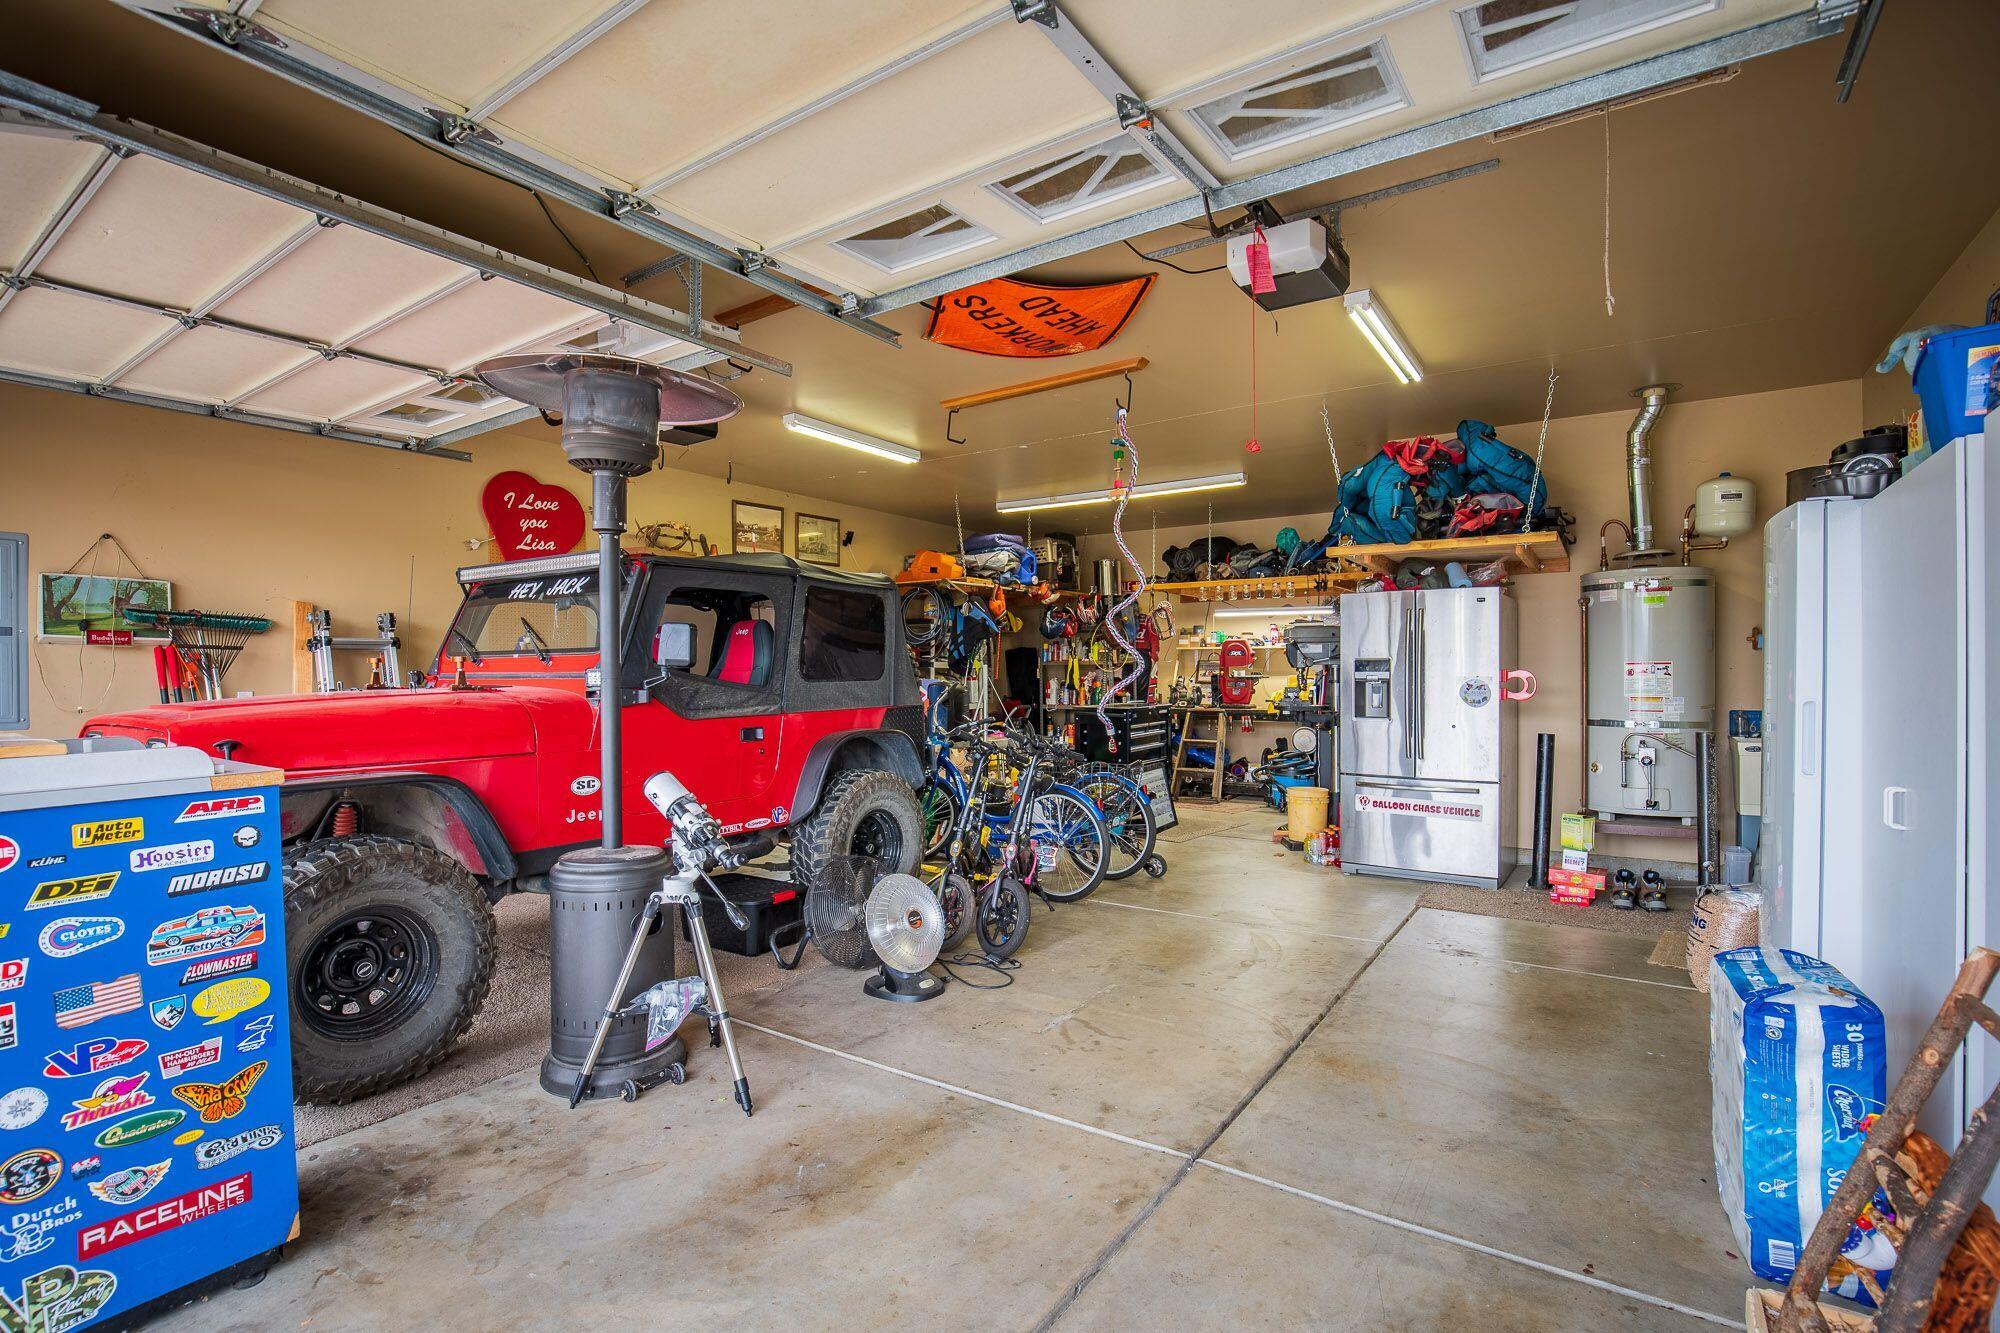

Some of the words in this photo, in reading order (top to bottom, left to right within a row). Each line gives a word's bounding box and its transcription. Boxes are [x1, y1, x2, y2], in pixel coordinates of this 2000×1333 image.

[1019, 296, 1107, 336] AHEAD
[503, 491, 517, 509] I
[518, 493, 560, 511] Love
[519, 517, 549, 532] you
[516, 533, 557, 552] Lisa
[508, 581, 538, 600] HEY,
[546, 576, 590, 597] JACK
[92, 634, 129, 642] Budwiser
[183, 796, 262, 815] ARP
[1372, 800, 1411, 811] BALLOON
[1412, 804, 1442, 814] CHASE
[1443, 806, 1481, 818] VEHICLE
[91, 829, 140, 844] Meter
[95, 821, 133, 833] Auto
[133, 843, 212, 868] Hoosier
[168, 862, 267, 893] MOROSO
[60, 925, 112, 942] CLOYES
[182, 953, 254, 983] FLOWMASTER
[1845, 1022, 1865, 1043] 30
[164, 1047, 201, 1062] IN-N-OUT
[166, 1049, 215, 1068] HAMBURGERS
[1831, 1044, 1841, 1069] SHEETS
[1840, 1044, 1850, 1068] WIDER
[104, 1117, 176, 1144] Quadratec
[82, 1177, 244, 1251] RACELINE
[180, 1195, 245, 1225] WHEELS
